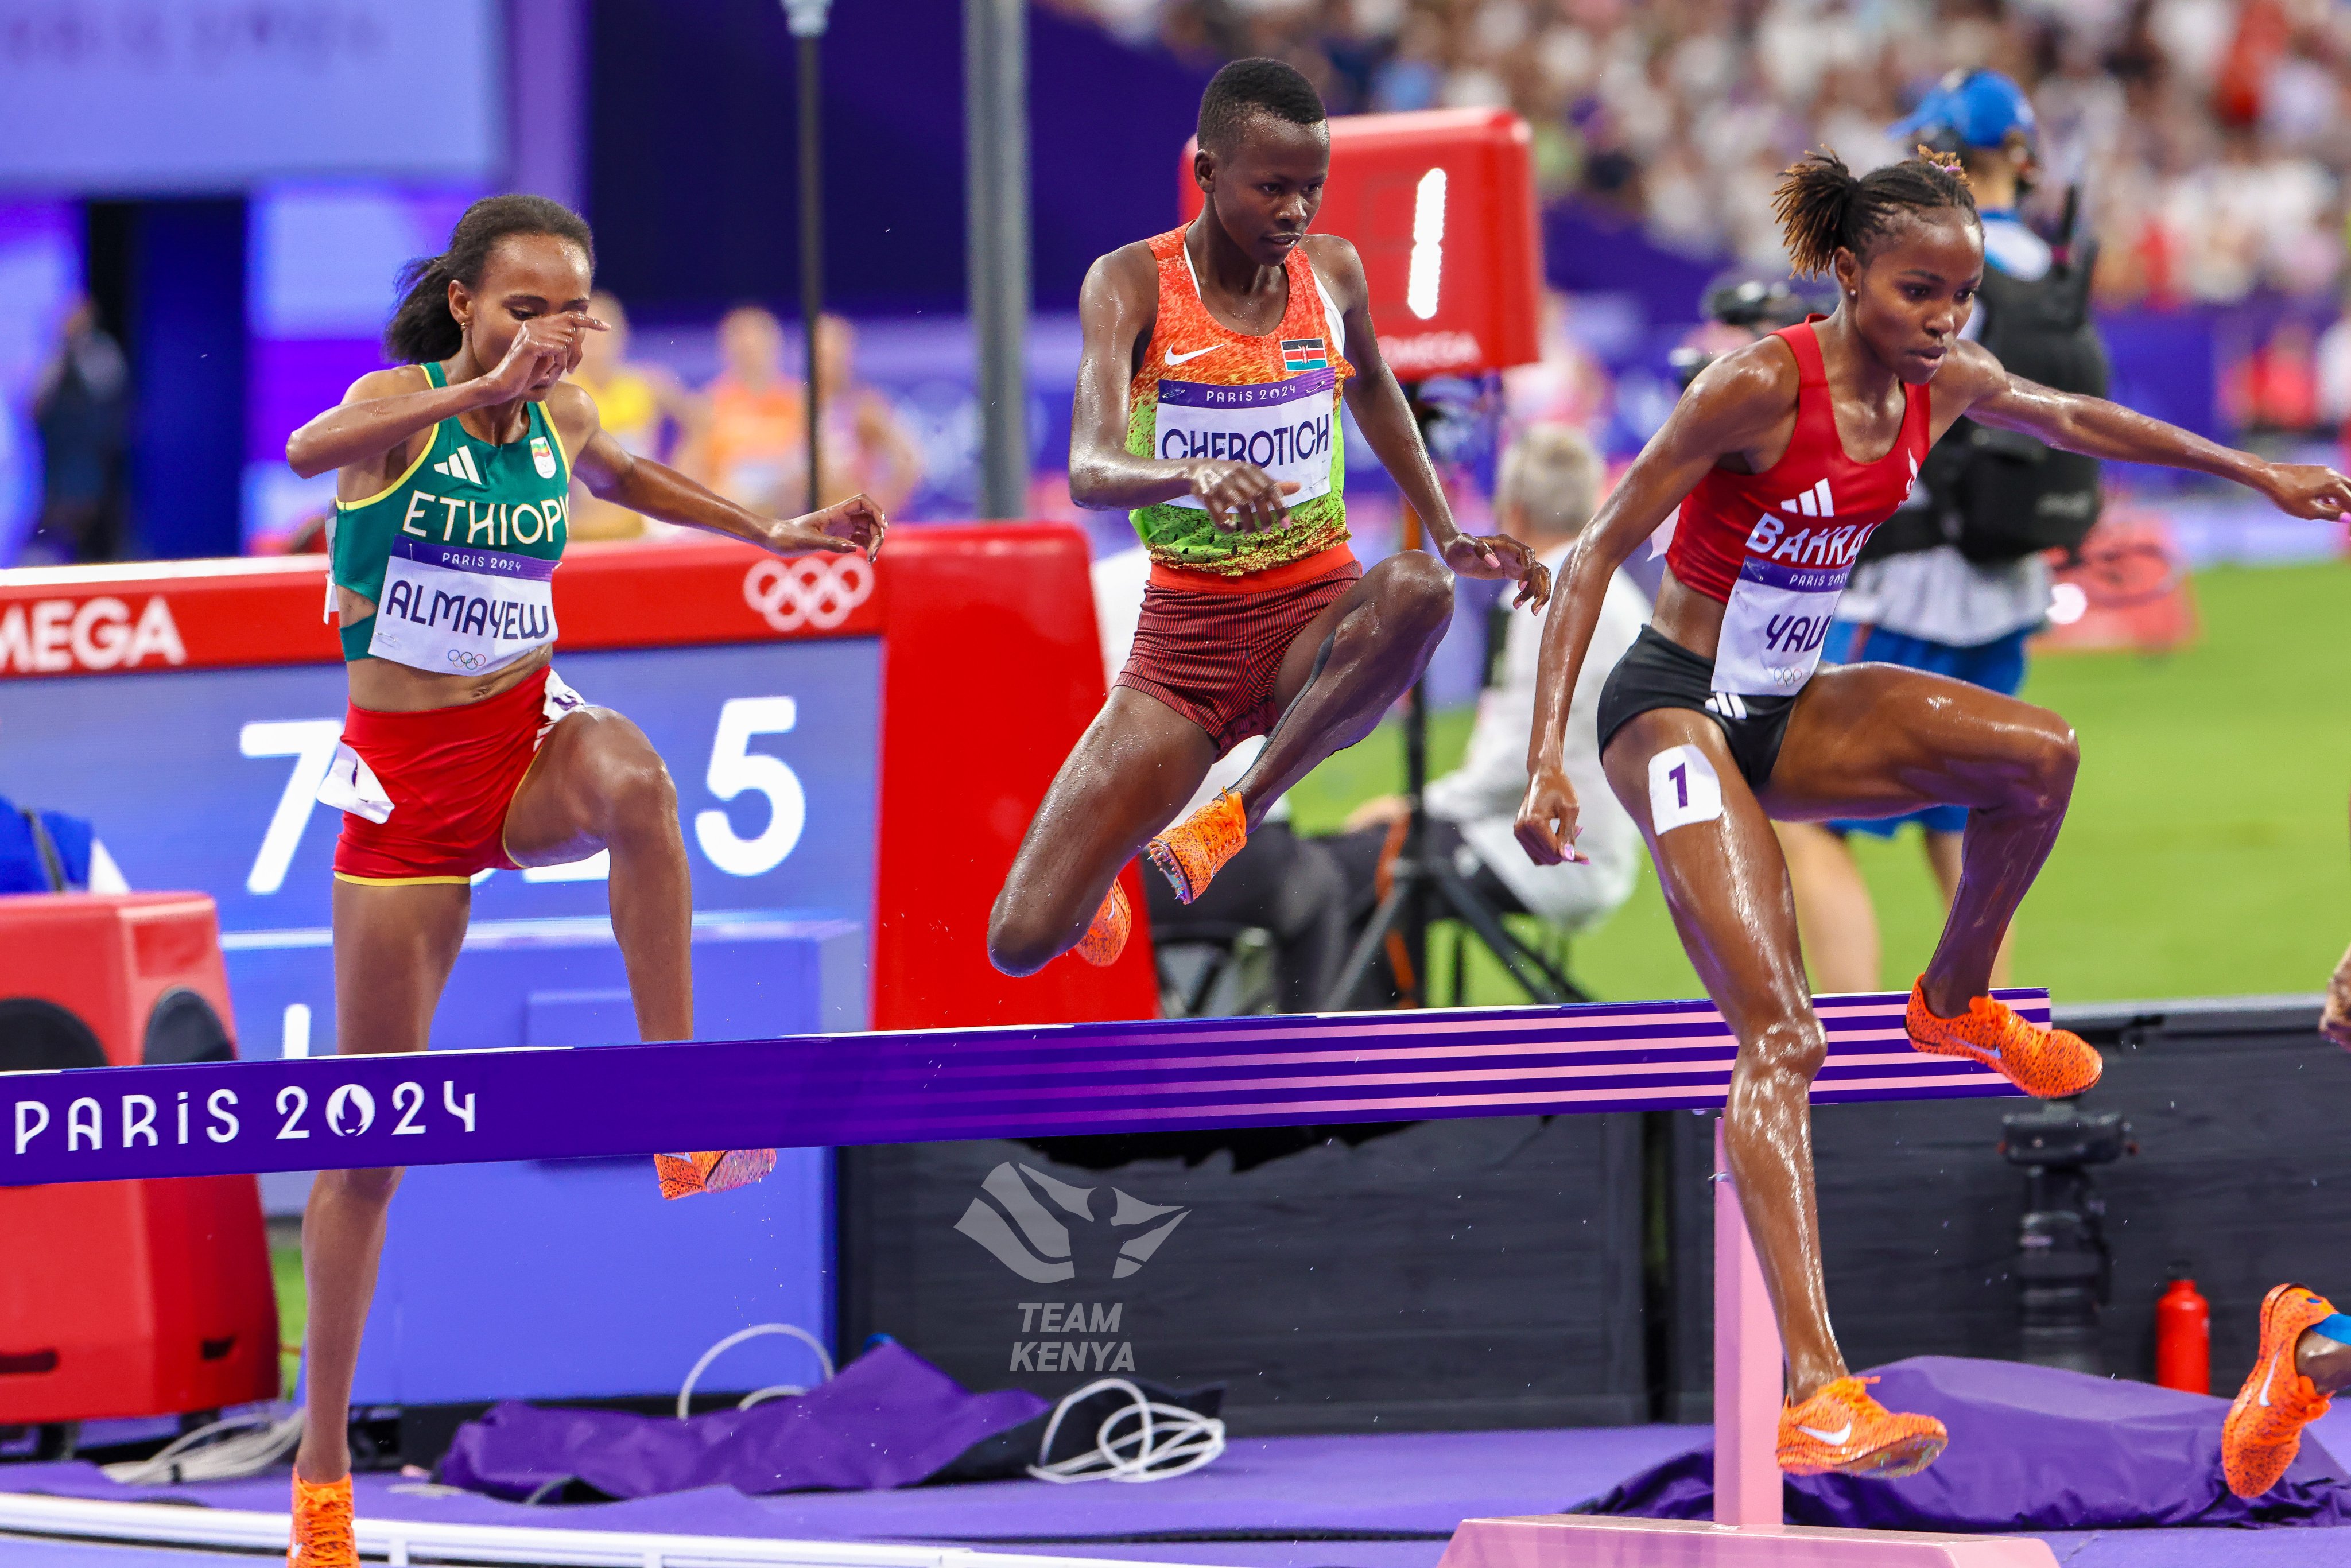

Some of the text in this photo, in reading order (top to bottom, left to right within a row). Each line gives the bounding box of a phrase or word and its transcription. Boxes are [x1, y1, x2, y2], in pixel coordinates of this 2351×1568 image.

[1407, 168, 1447, 319] 1
[1259, 384, 1296, 401] 2024
[1161, 413, 1329, 469] CHEROTICH
[402, 490, 569, 545] ETHIOPI
[1745, 511, 1883, 566] BAHRA
[490, 557, 521, 572] 2024
[386, 580, 549, 639] ALMAYEW
[1669, 762, 1688, 809] 1
[274, 1080, 476, 1140] 2024
